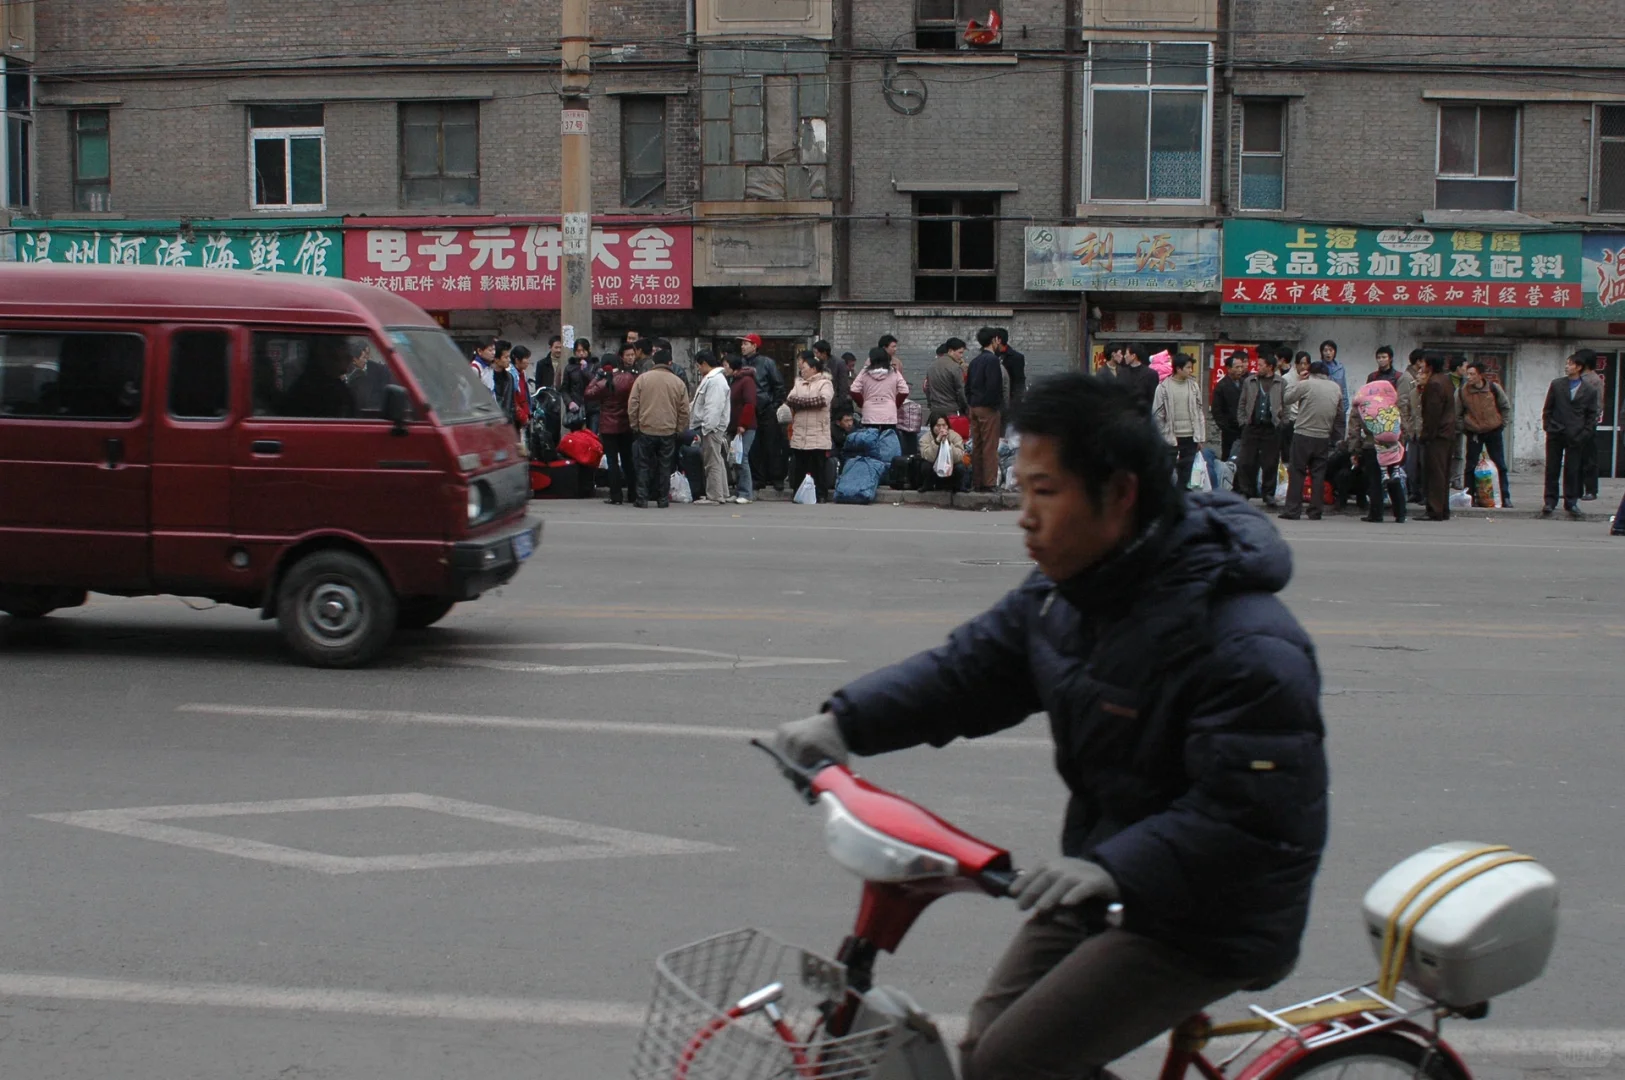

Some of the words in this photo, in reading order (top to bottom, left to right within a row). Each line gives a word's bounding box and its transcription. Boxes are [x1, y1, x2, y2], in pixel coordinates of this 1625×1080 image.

[366, 227, 675, 271] 电子元件大全
[1285, 228, 1357, 249] 上海
[1244, 249, 1565, 279] 食品添加剂及配料
[359, 275, 434, 292] 洗衣机配件
[441, 275, 472, 291] 冰箱
[479, 275, 556, 291] 影碟机配件
[591, 276, 622, 289] VCD
[1033, 277, 1215, 288] 迎泽区计生用品专卖店
[1231, 280, 1570, 307] 太原市健鹰食品添加剂经营部
